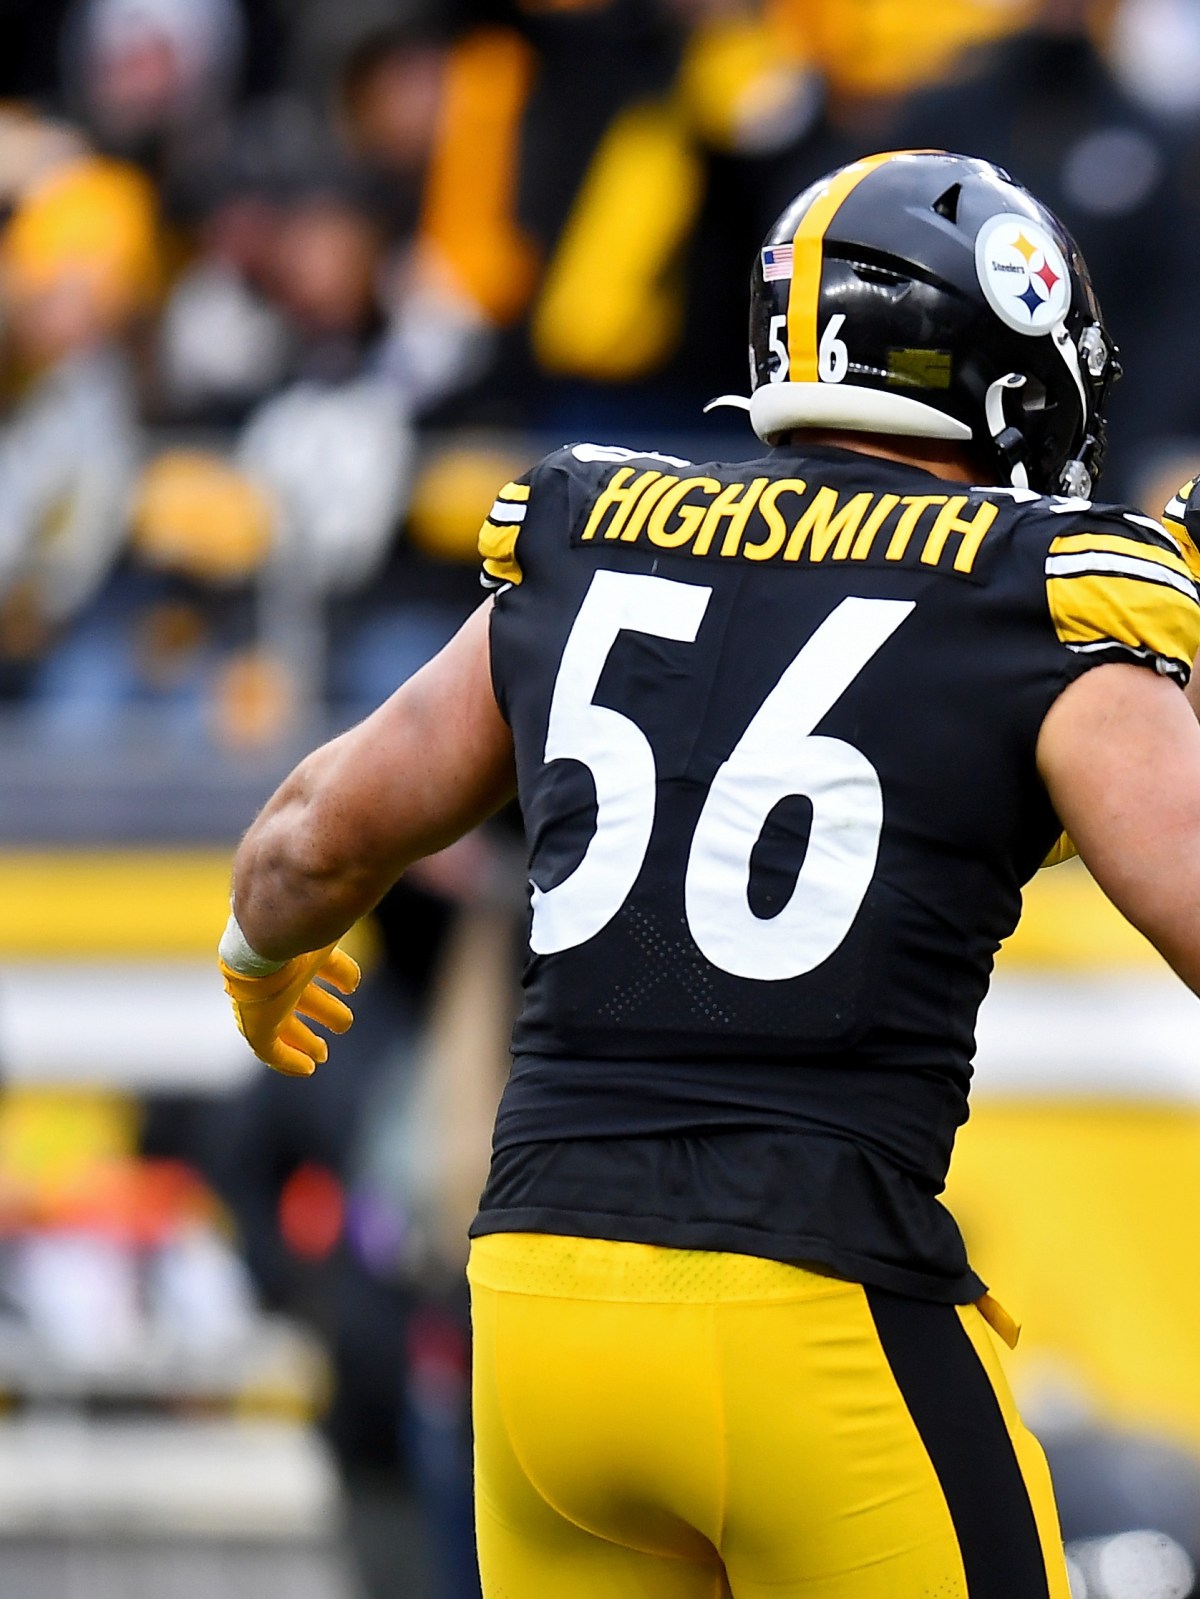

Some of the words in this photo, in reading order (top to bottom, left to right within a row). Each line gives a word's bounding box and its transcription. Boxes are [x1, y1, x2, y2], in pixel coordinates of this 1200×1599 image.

[991, 260, 1026, 275] Steelers
[581, 466, 1000, 574] HIGHSMITH
[529, 568, 917, 982] 56
